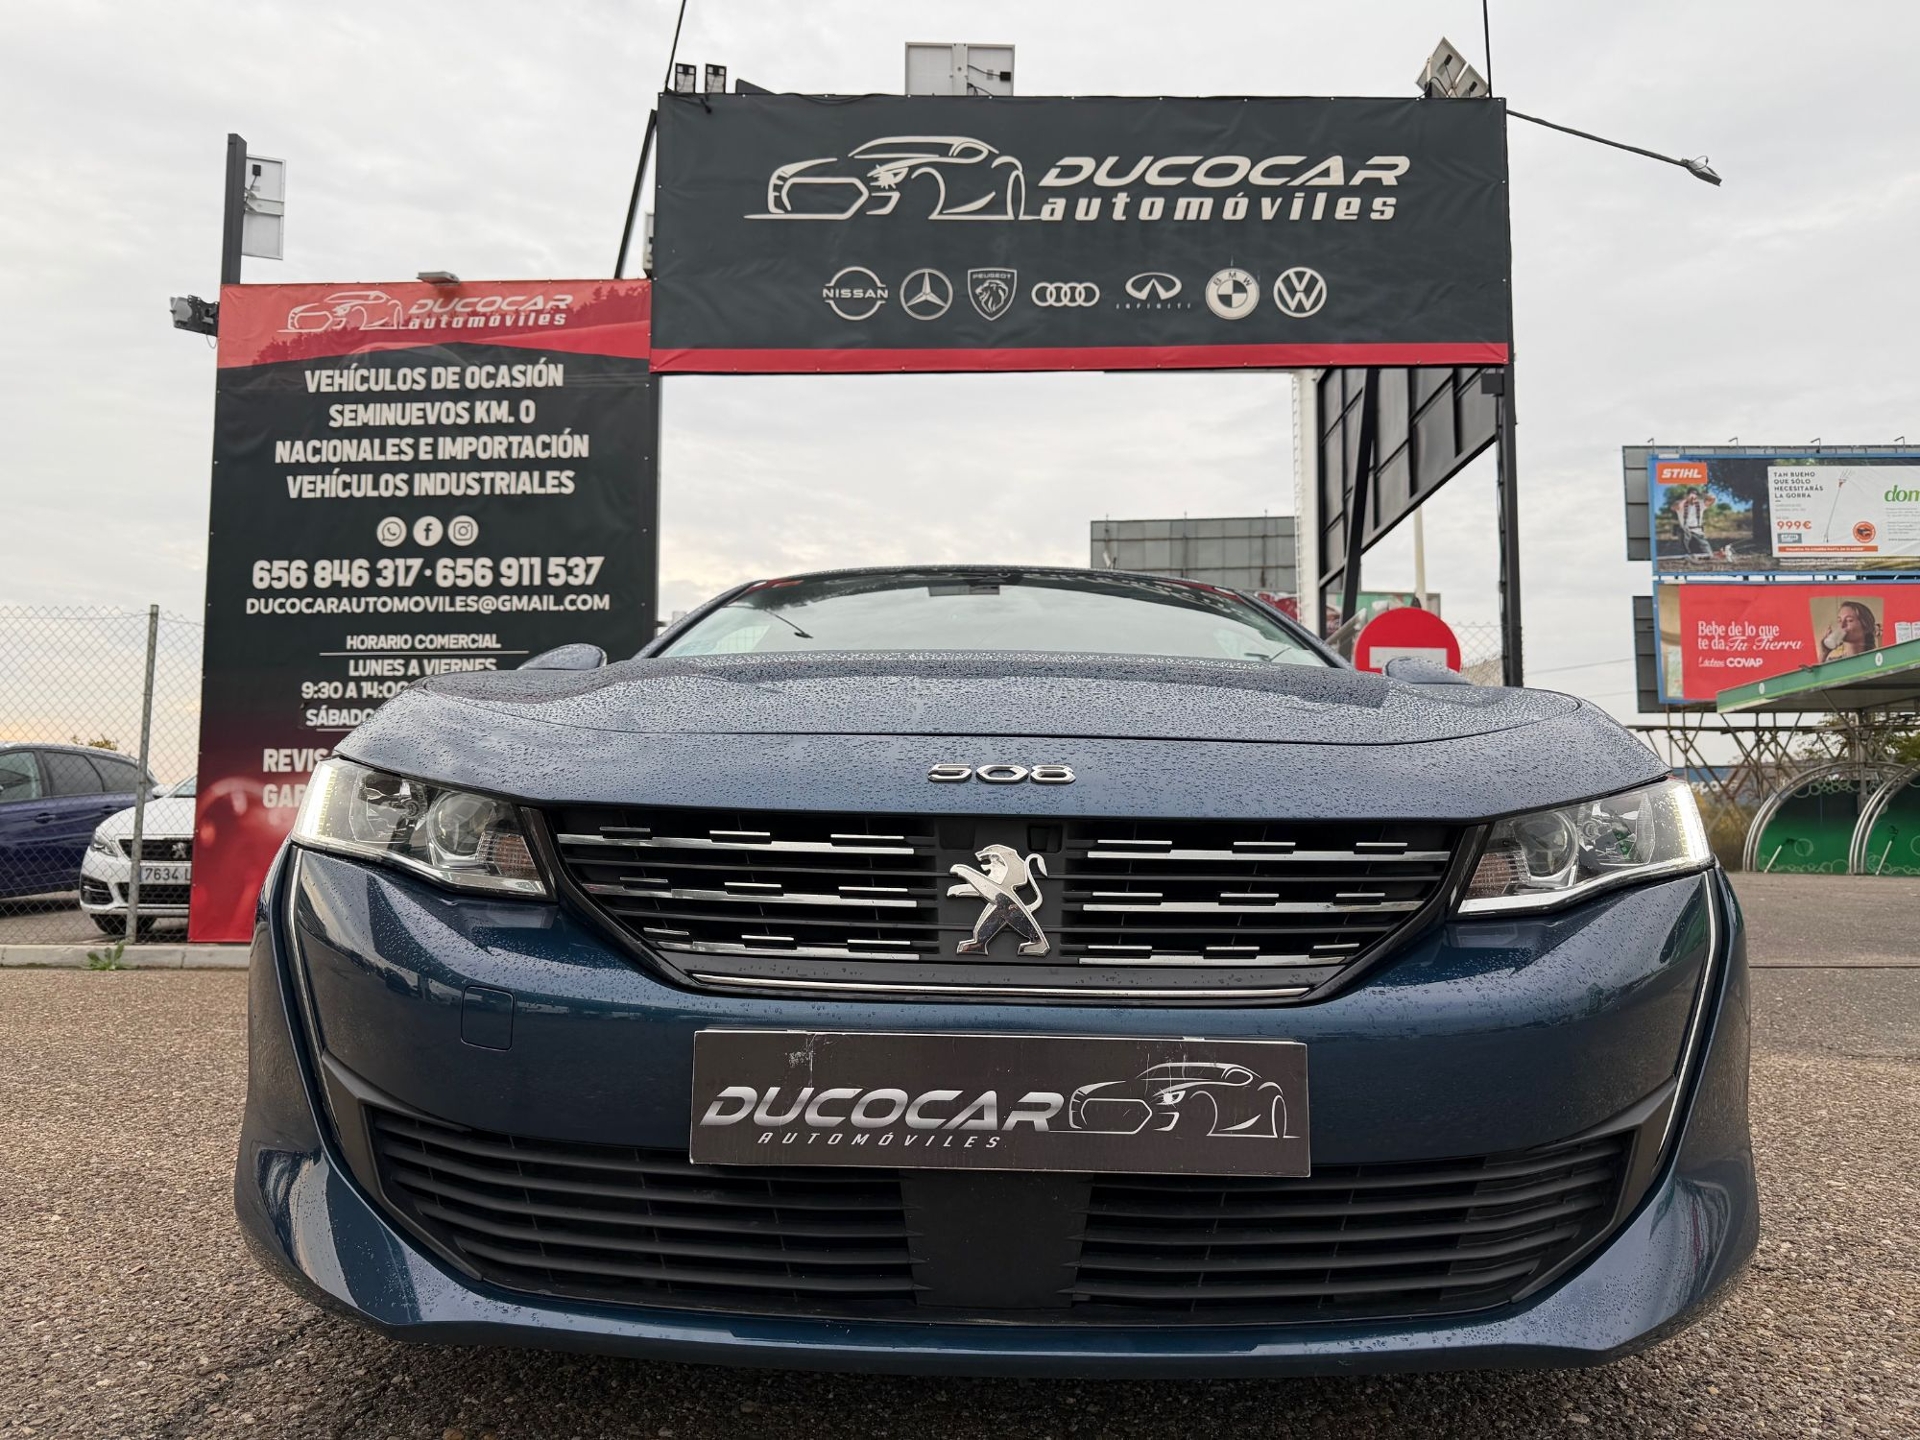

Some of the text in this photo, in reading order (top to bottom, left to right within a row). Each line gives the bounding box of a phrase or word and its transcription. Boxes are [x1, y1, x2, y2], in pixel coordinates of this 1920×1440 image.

[1038, 154, 1411, 188] DUCOCAR
[1040, 192, 1398, 222] automóviles
[971, 272, 1012, 280] PEUGEOT
[822, 288, 889, 299] NISSAN
[409, 295, 573, 312] DUCOCAR
[408, 312, 567, 330] automóviles
[305, 358, 564, 393] VEHÍCULOS DE OCASIÓN
[328, 400, 470, 427] SEMINUEVOS
[474, 400, 514, 424] KM.
[275, 428, 589, 464] NACIONALES E IMPORTACIÓN
[1661, 468, 1702, 479] STIHL
[286, 468, 576, 499] VEHÍCULOS INDUSTRIALES
[1774, 484, 1824, 492] NECESITARÁS
[1777, 520, 1812, 530] 999€
[252, 560, 307, 590] 656
[313, 559, 368, 588] 846
[499, 558, 542, 587] 911
[547, 556, 606, 585] 537
[246, 593, 610, 615] DUCOCARAUTOMOVILES@GMAIL.COM
[1698, 620, 1780, 639] Bebe de lo que
[346, 633, 502, 650] HORARIO COMERCIAL
[1698, 635, 1803, 651] te da Tu Tierra
[348, 658, 497, 677] LUNES A VIERNES
[1726, 657, 1763, 668] COVAP
[301, 681, 344, 700] 9:30
[345, 681, 358, 699] A
[927, 763, 1077, 784] 508
[145, 868, 180, 880] 7634
[699, 1085, 1065, 1132] DUCOCAR
[757, 1132, 1002, 1149] AUTOMÓVILES
